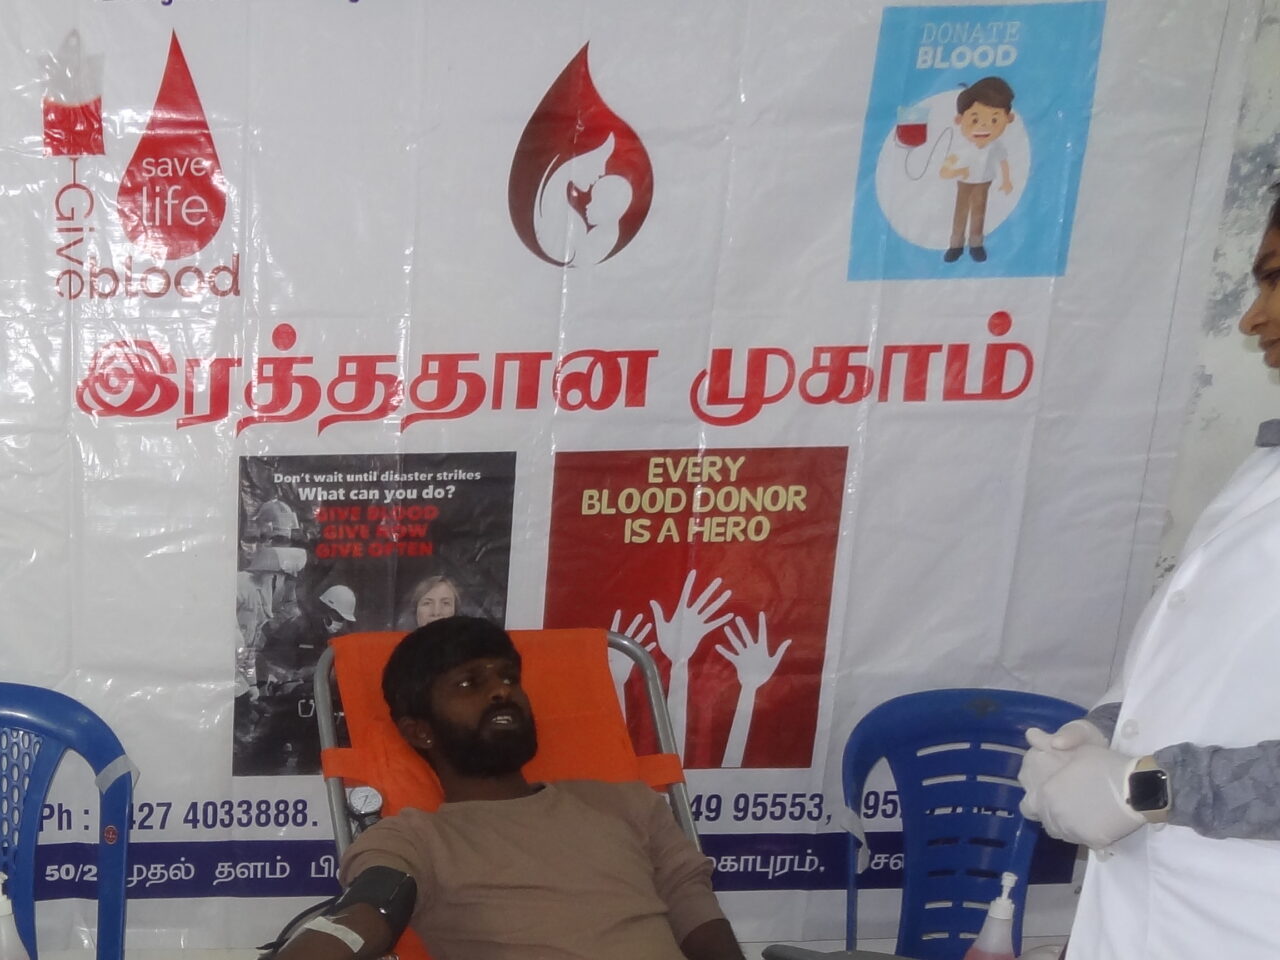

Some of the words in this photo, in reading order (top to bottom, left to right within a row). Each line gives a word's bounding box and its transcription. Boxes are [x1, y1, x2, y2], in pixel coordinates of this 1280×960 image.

[922, 20, 1021, 43] DONATE
[915, 44, 1018, 69] BLOOD
[142, 156, 208, 177] save
[142, 185, 209, 226] life
[55, 183, 95, 300] Give
[89, 253, 241, 299] blood
[75, 322, 660, 437] இரத்ததான
[689, 310, 1035, 427] முகாம்
[273, 473, 310, 484] Don't
[313, 471, 344, 483] wait
[346, 471, 377, 482] until
[380, 470, 434, 482] disaster
[436, 469, 482, 481] strikes
[648, 455, 746, 483] EVERY
[298, 487, 346, 501] What
[349, 489, 380, 500] can
[384, 487, 418, 503] you
[422, 485, 456, 499] do?
[581, 487, 687, 515] BLOOD
[692, 485, 808, 513] DONOR
[315, 506, 361, 522] GIVE
[322, 524, 370, 540] GIVE
[624, 518, 651, 543] IS
[657, 518, 680, 543] A
[687, 515, 771, 543] HERO
[315, 542, 364, 558] GIVE
[183, 799, 319, 831] 4033888.
[691, 793, 723, 822] 49
[733, 792, 832, 826] 95553,
[863, 790, 903, 819] 95
[212, 855, 291, 886] தளம்
